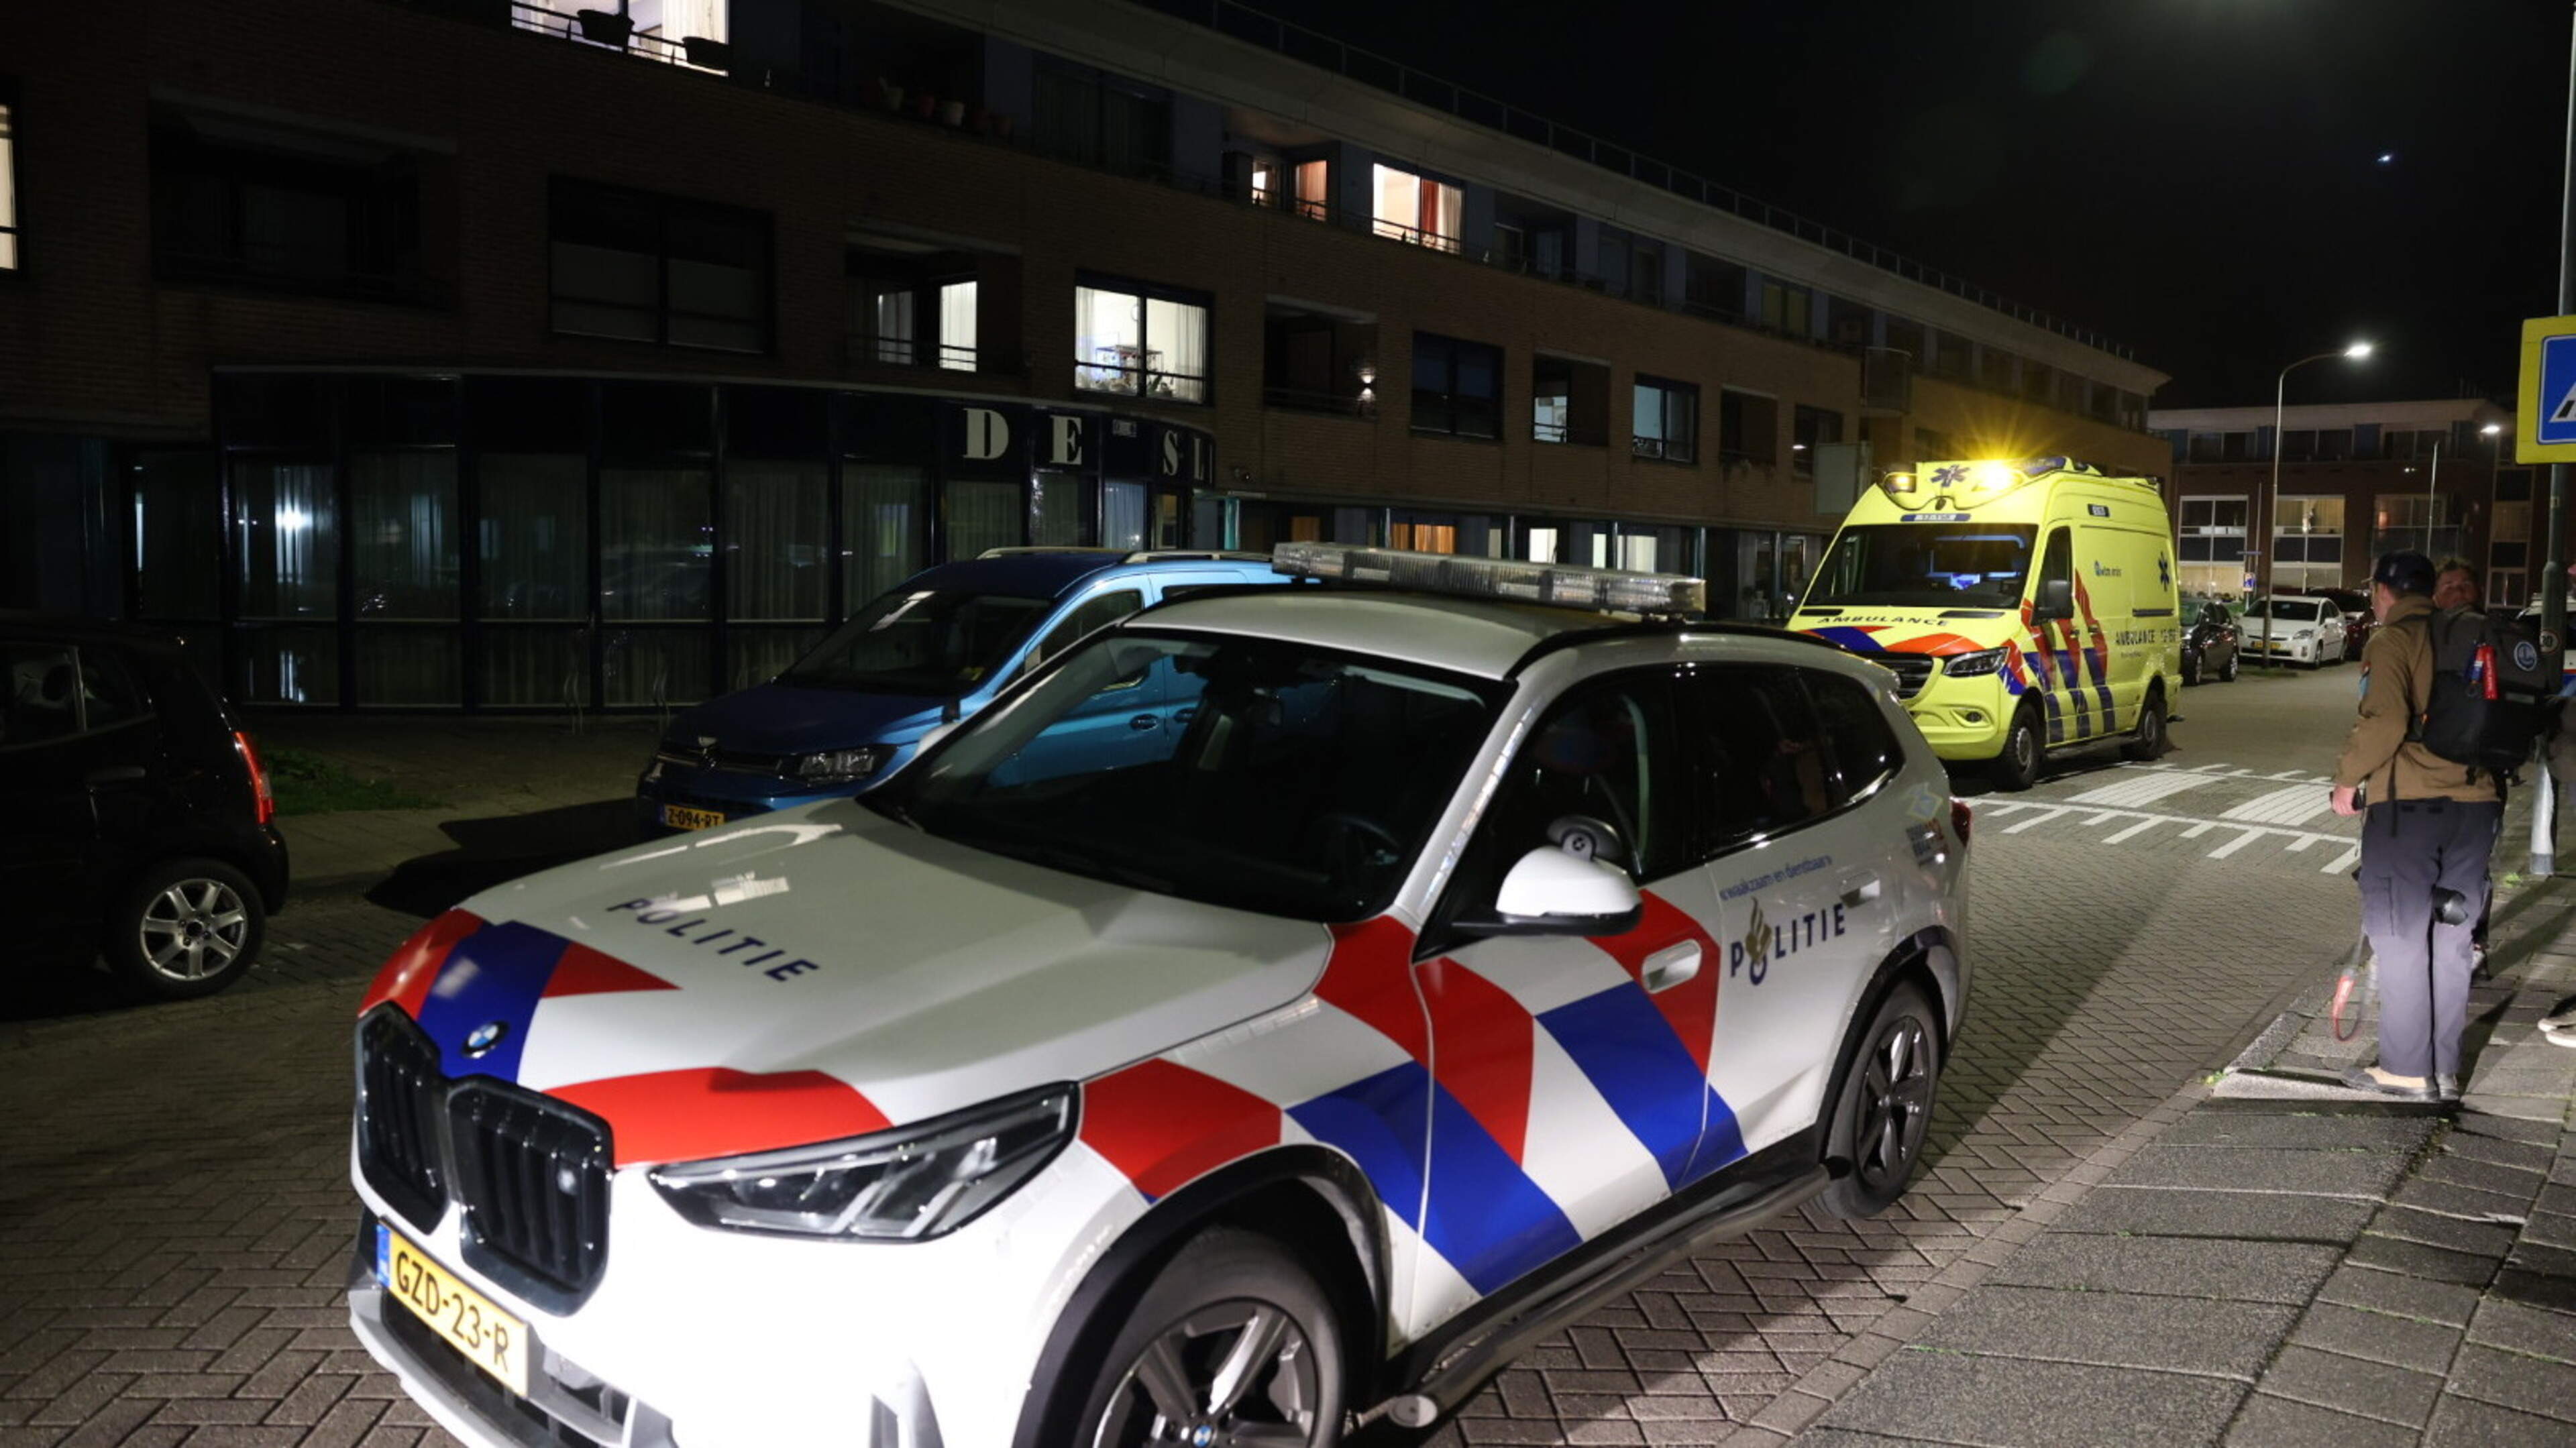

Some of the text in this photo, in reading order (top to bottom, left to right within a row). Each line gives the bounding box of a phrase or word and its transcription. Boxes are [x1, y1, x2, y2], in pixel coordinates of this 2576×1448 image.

[963, 407, 1083, 465] DE
[1817, 616, 1949, 626] AMBULANCE
[606, 898, 820, 982] POLITIE
[1731, 900, 1846, 986] POLITIE
[396, 1250, 509, 1374] GZD-23-R
